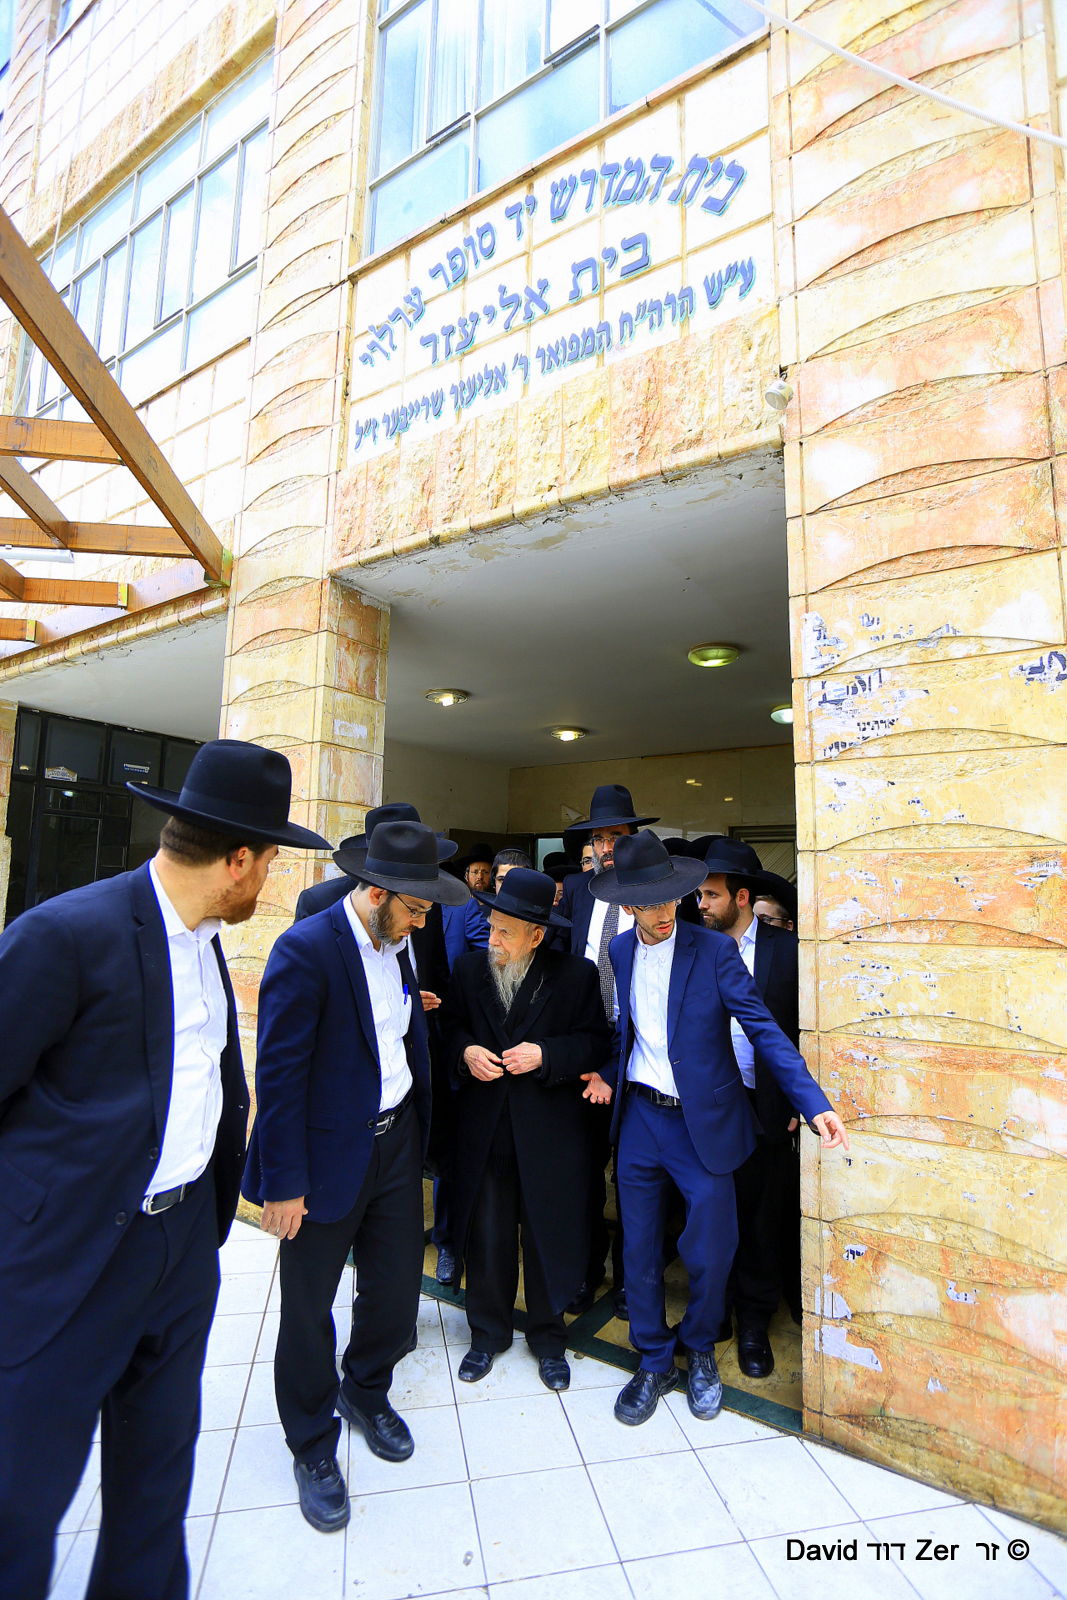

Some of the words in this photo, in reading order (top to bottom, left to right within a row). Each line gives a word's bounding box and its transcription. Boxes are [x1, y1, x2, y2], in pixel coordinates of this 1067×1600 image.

[550, 153, 674, 223] המדרש
[668, 153, 748, 216] בית
[505, 195, 537, 240] יד
[429, 223, 497, 291] סופר
[569, 232, 651, 301] בית
[420, 278, 551, 368] אליעזר
[535, 320, 612, 376] המפואר
[382, 388, 446, 439] שרייבער
[450, 362, 508, 411] אליעזר
